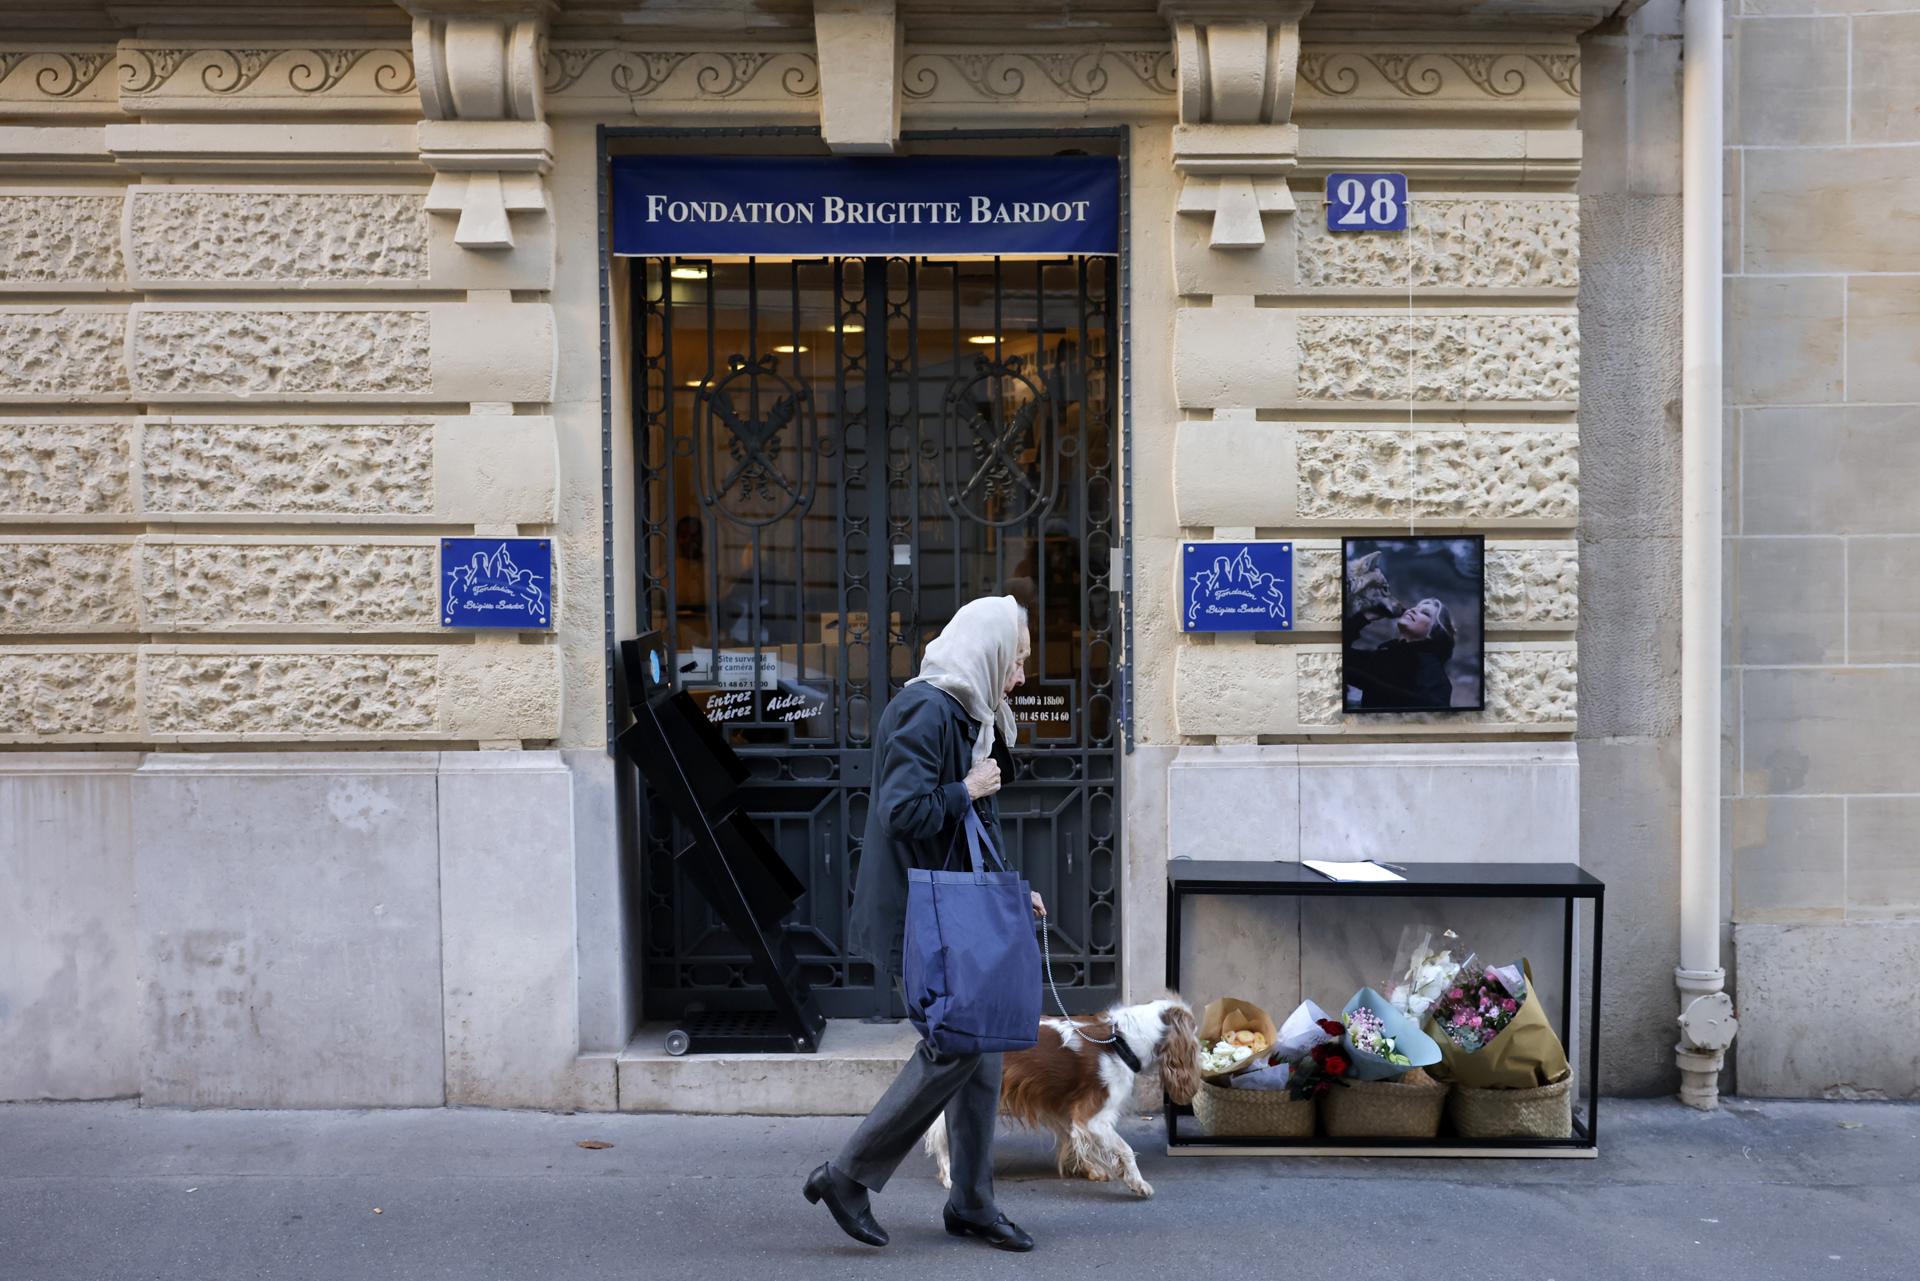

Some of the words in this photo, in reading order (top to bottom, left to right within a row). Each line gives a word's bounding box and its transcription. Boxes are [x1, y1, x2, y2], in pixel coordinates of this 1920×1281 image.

[645, 194, 815, 224] FONDATION
[821, 195, 962, 225] BRIGITTE
[968, 195, 1090, 224] BARDOT
[1337, 178, 1398, 225] 28
[472, 583, 516, 597] Fondation
[1214, 588, 1257, 601] Fondation
[725, 663, 753, 671] caméra
[706, 690, 752, 709] Entrez
[766, 694, 806, 712] Aidez
[1014, 695, 1036, 705] 10h00
[1043, 695, 1065, 705] 18h00
[704, 705, 752, 723] dhérez
[1019, 711, 1028, 721] 01
[1030, 711, 1039, 721] 45
[1040, 711, 1049, 721] 05
[1050, 711, 1059, 721] 14
